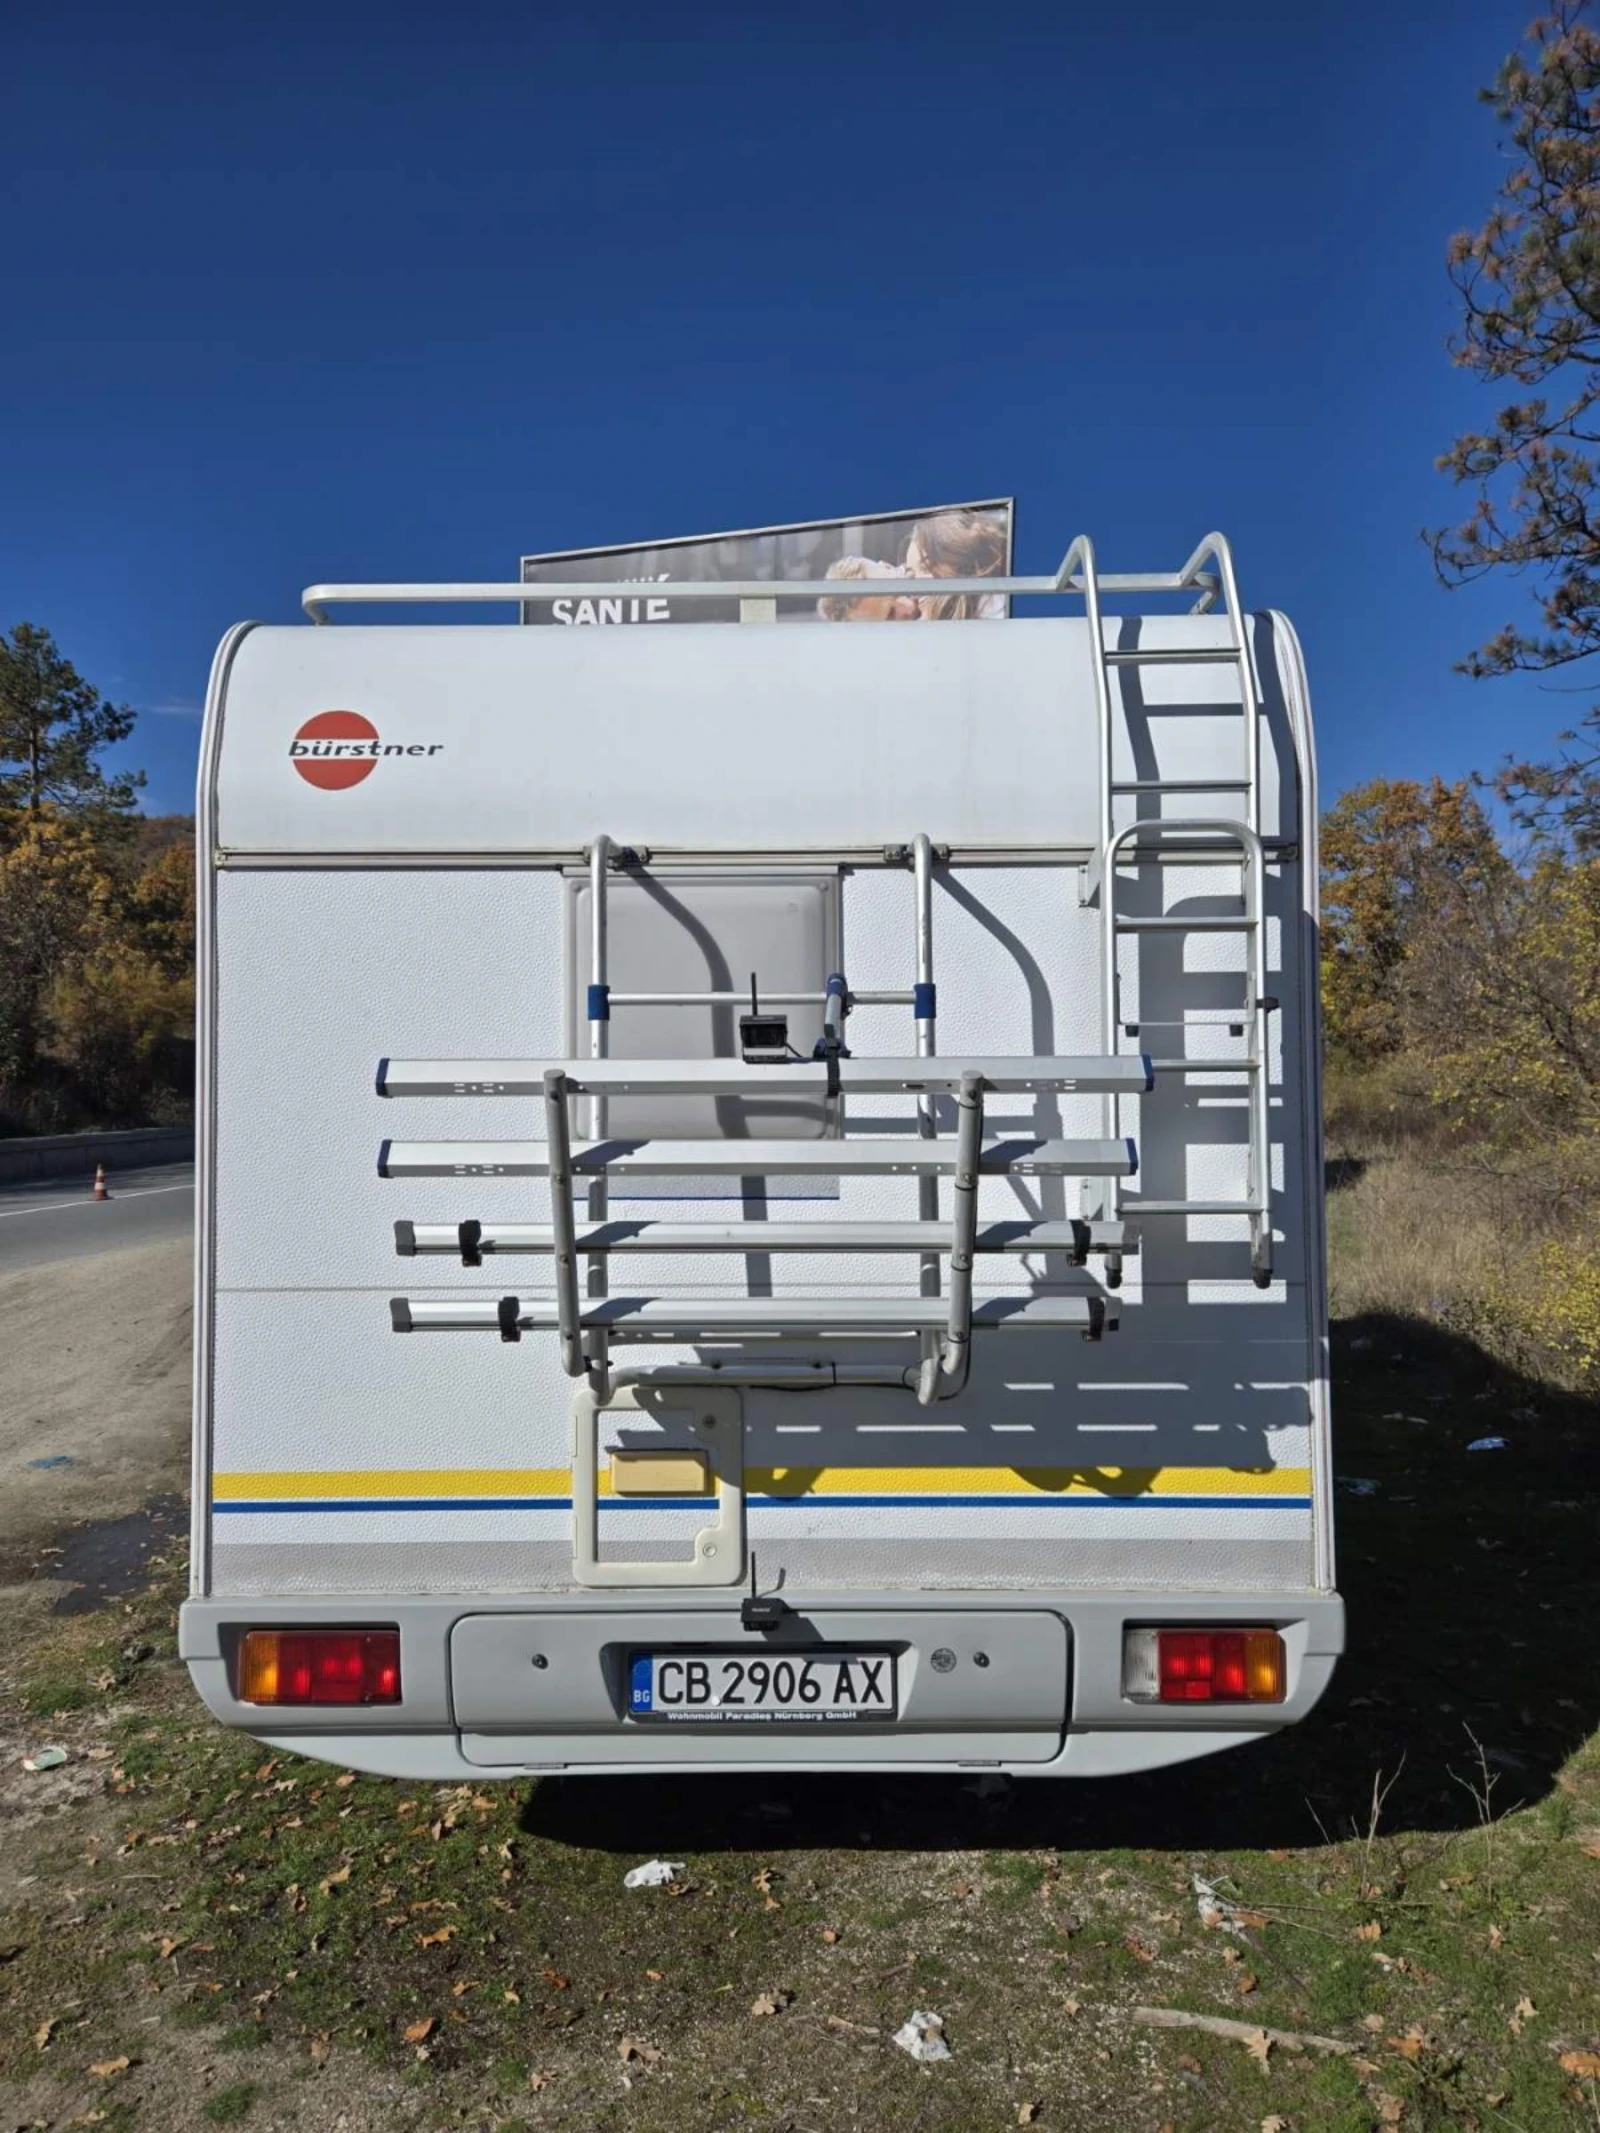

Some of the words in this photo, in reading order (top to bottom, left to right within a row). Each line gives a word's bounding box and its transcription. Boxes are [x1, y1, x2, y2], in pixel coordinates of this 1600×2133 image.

[288, 740, 444, 756] bürstner
[658, 1661, 712, 1704] CB
[721, 1661, 821, 1704] 2906
[832, 1660, 885, 1704] AX
[633, 1689, 651, 1703] BG
[667, 1712, 723, 1720] Wohnmobil
[725, 1712, 772, 1720] Paradies
[773, 1711, 823, 1721] Nürnberg
[825, 1711, 857, 1719] GmbH
